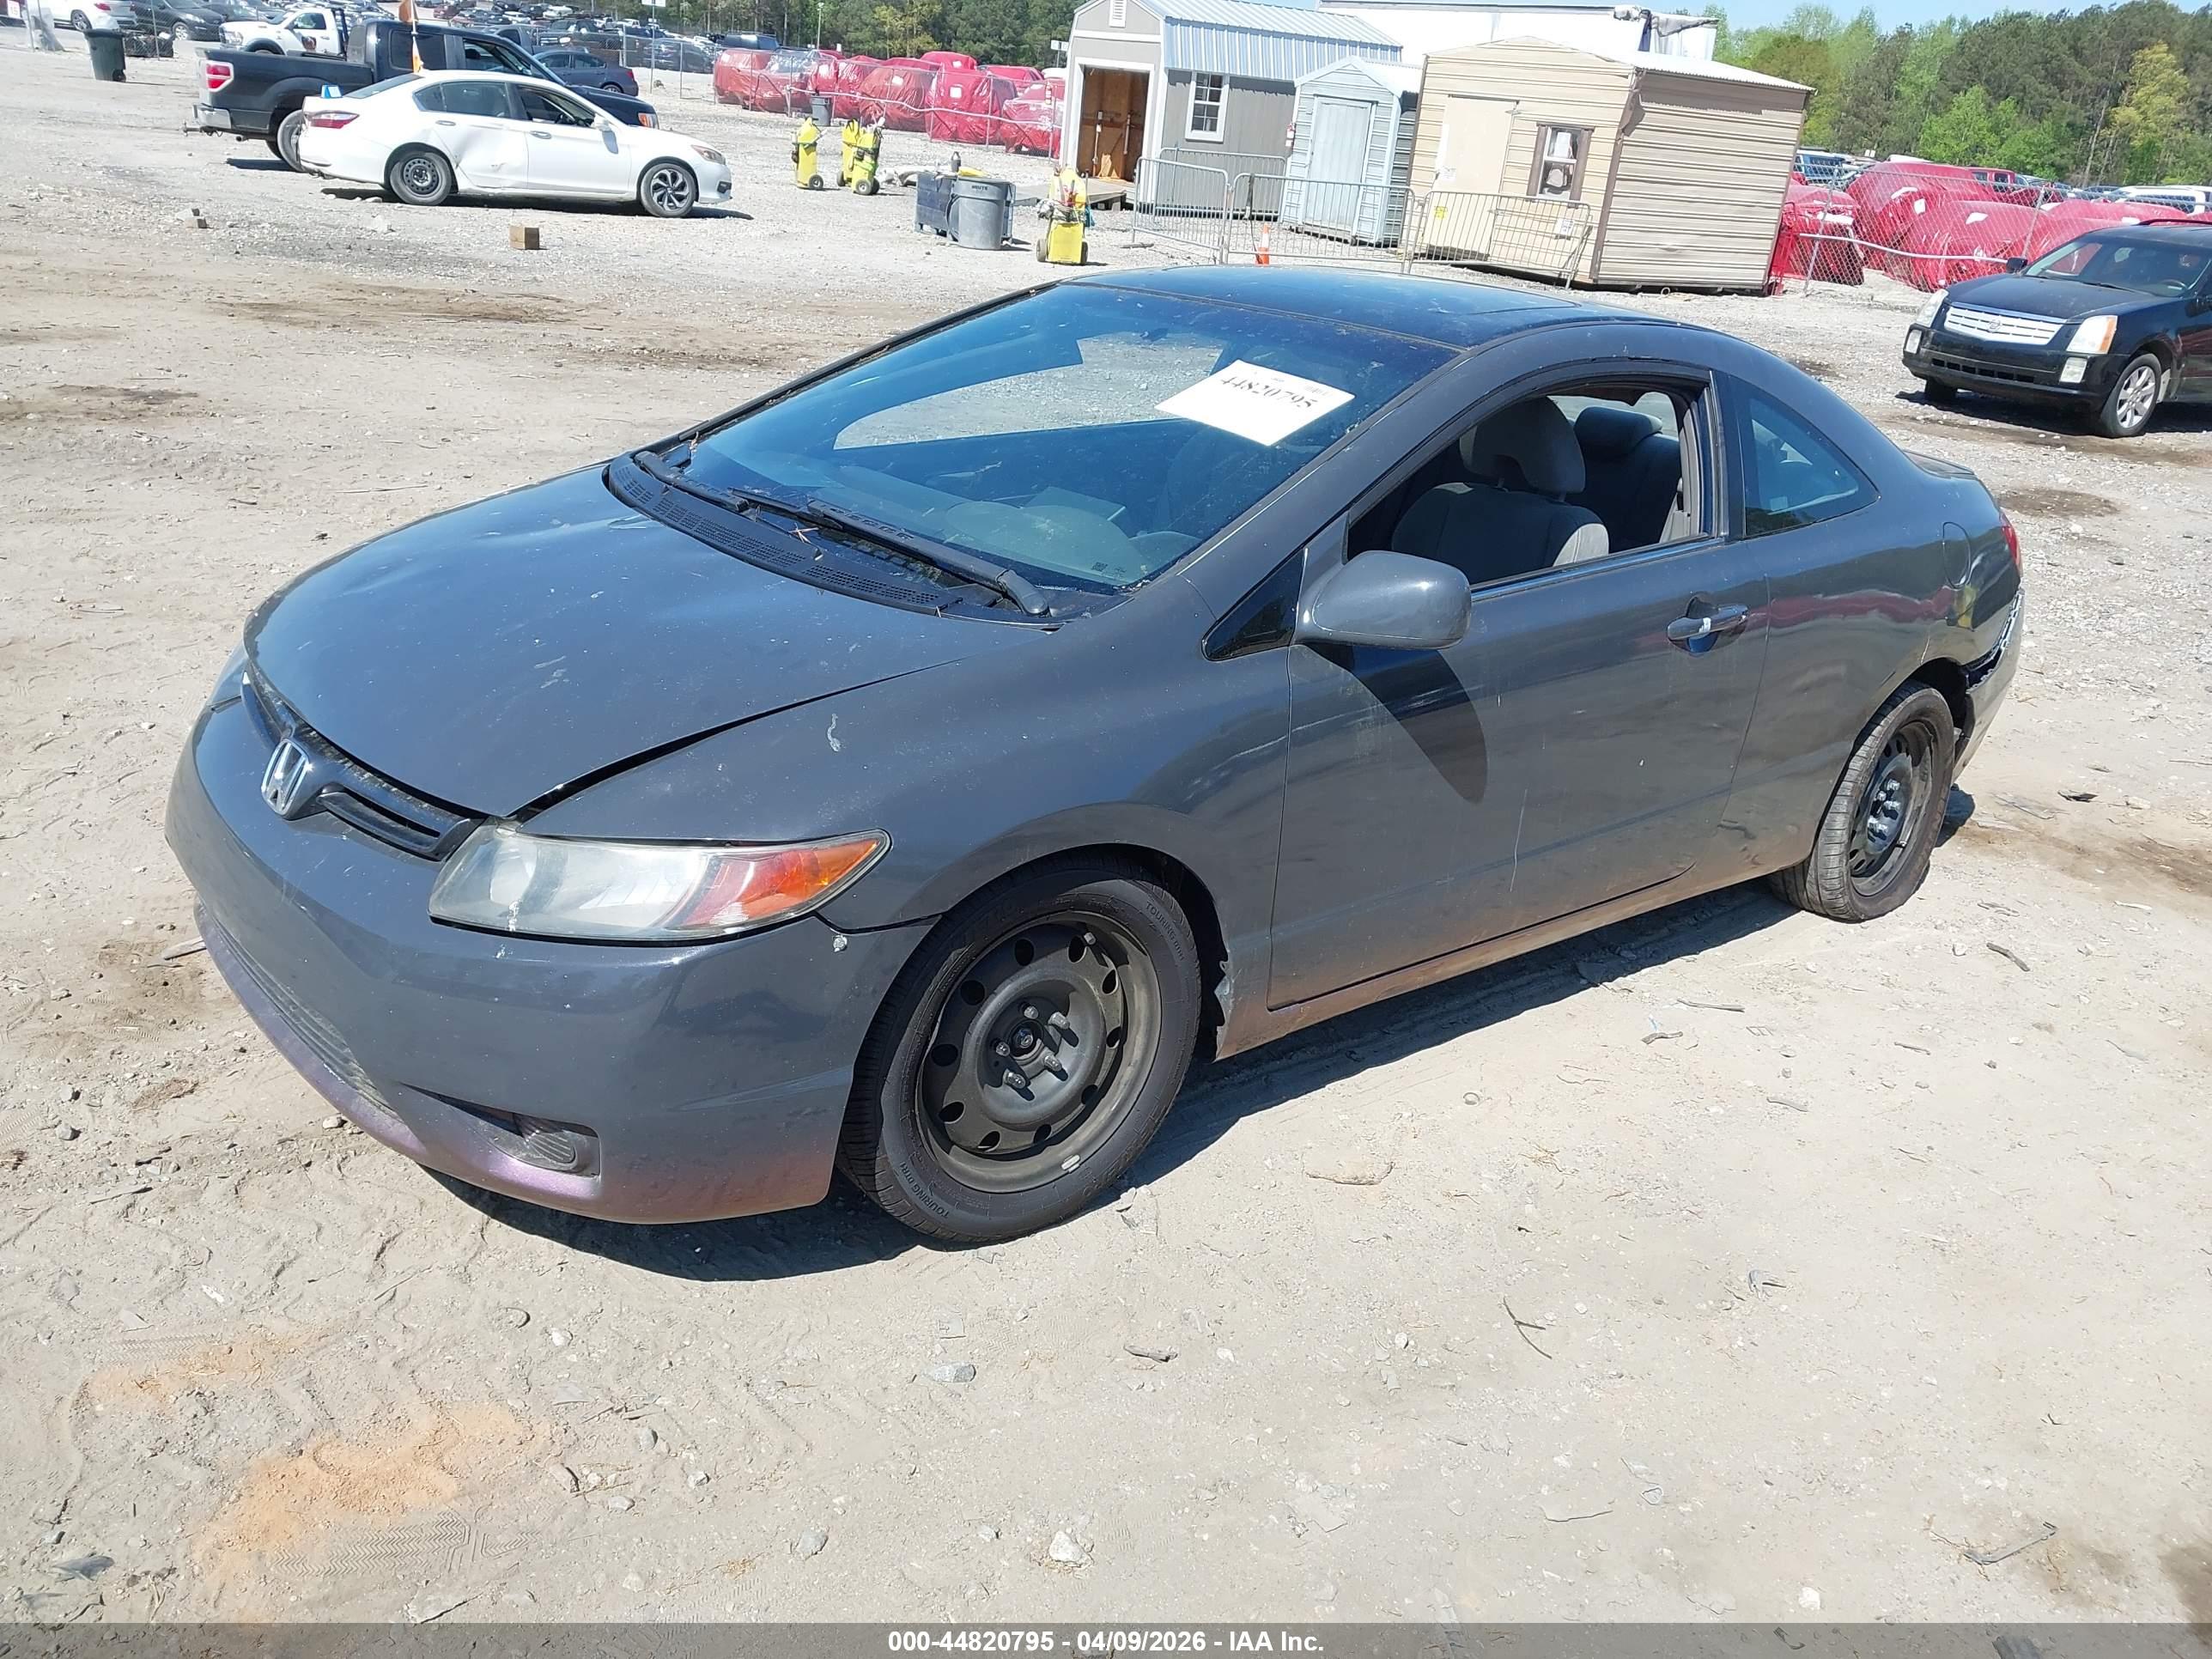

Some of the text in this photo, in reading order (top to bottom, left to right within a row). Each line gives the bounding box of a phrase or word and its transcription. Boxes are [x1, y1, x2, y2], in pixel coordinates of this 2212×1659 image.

[1220, 376, 1318, 408] 44820795
[1146, 901, 1176, 940] TOURING
[912, 1185, 951, 1219] TOURING
